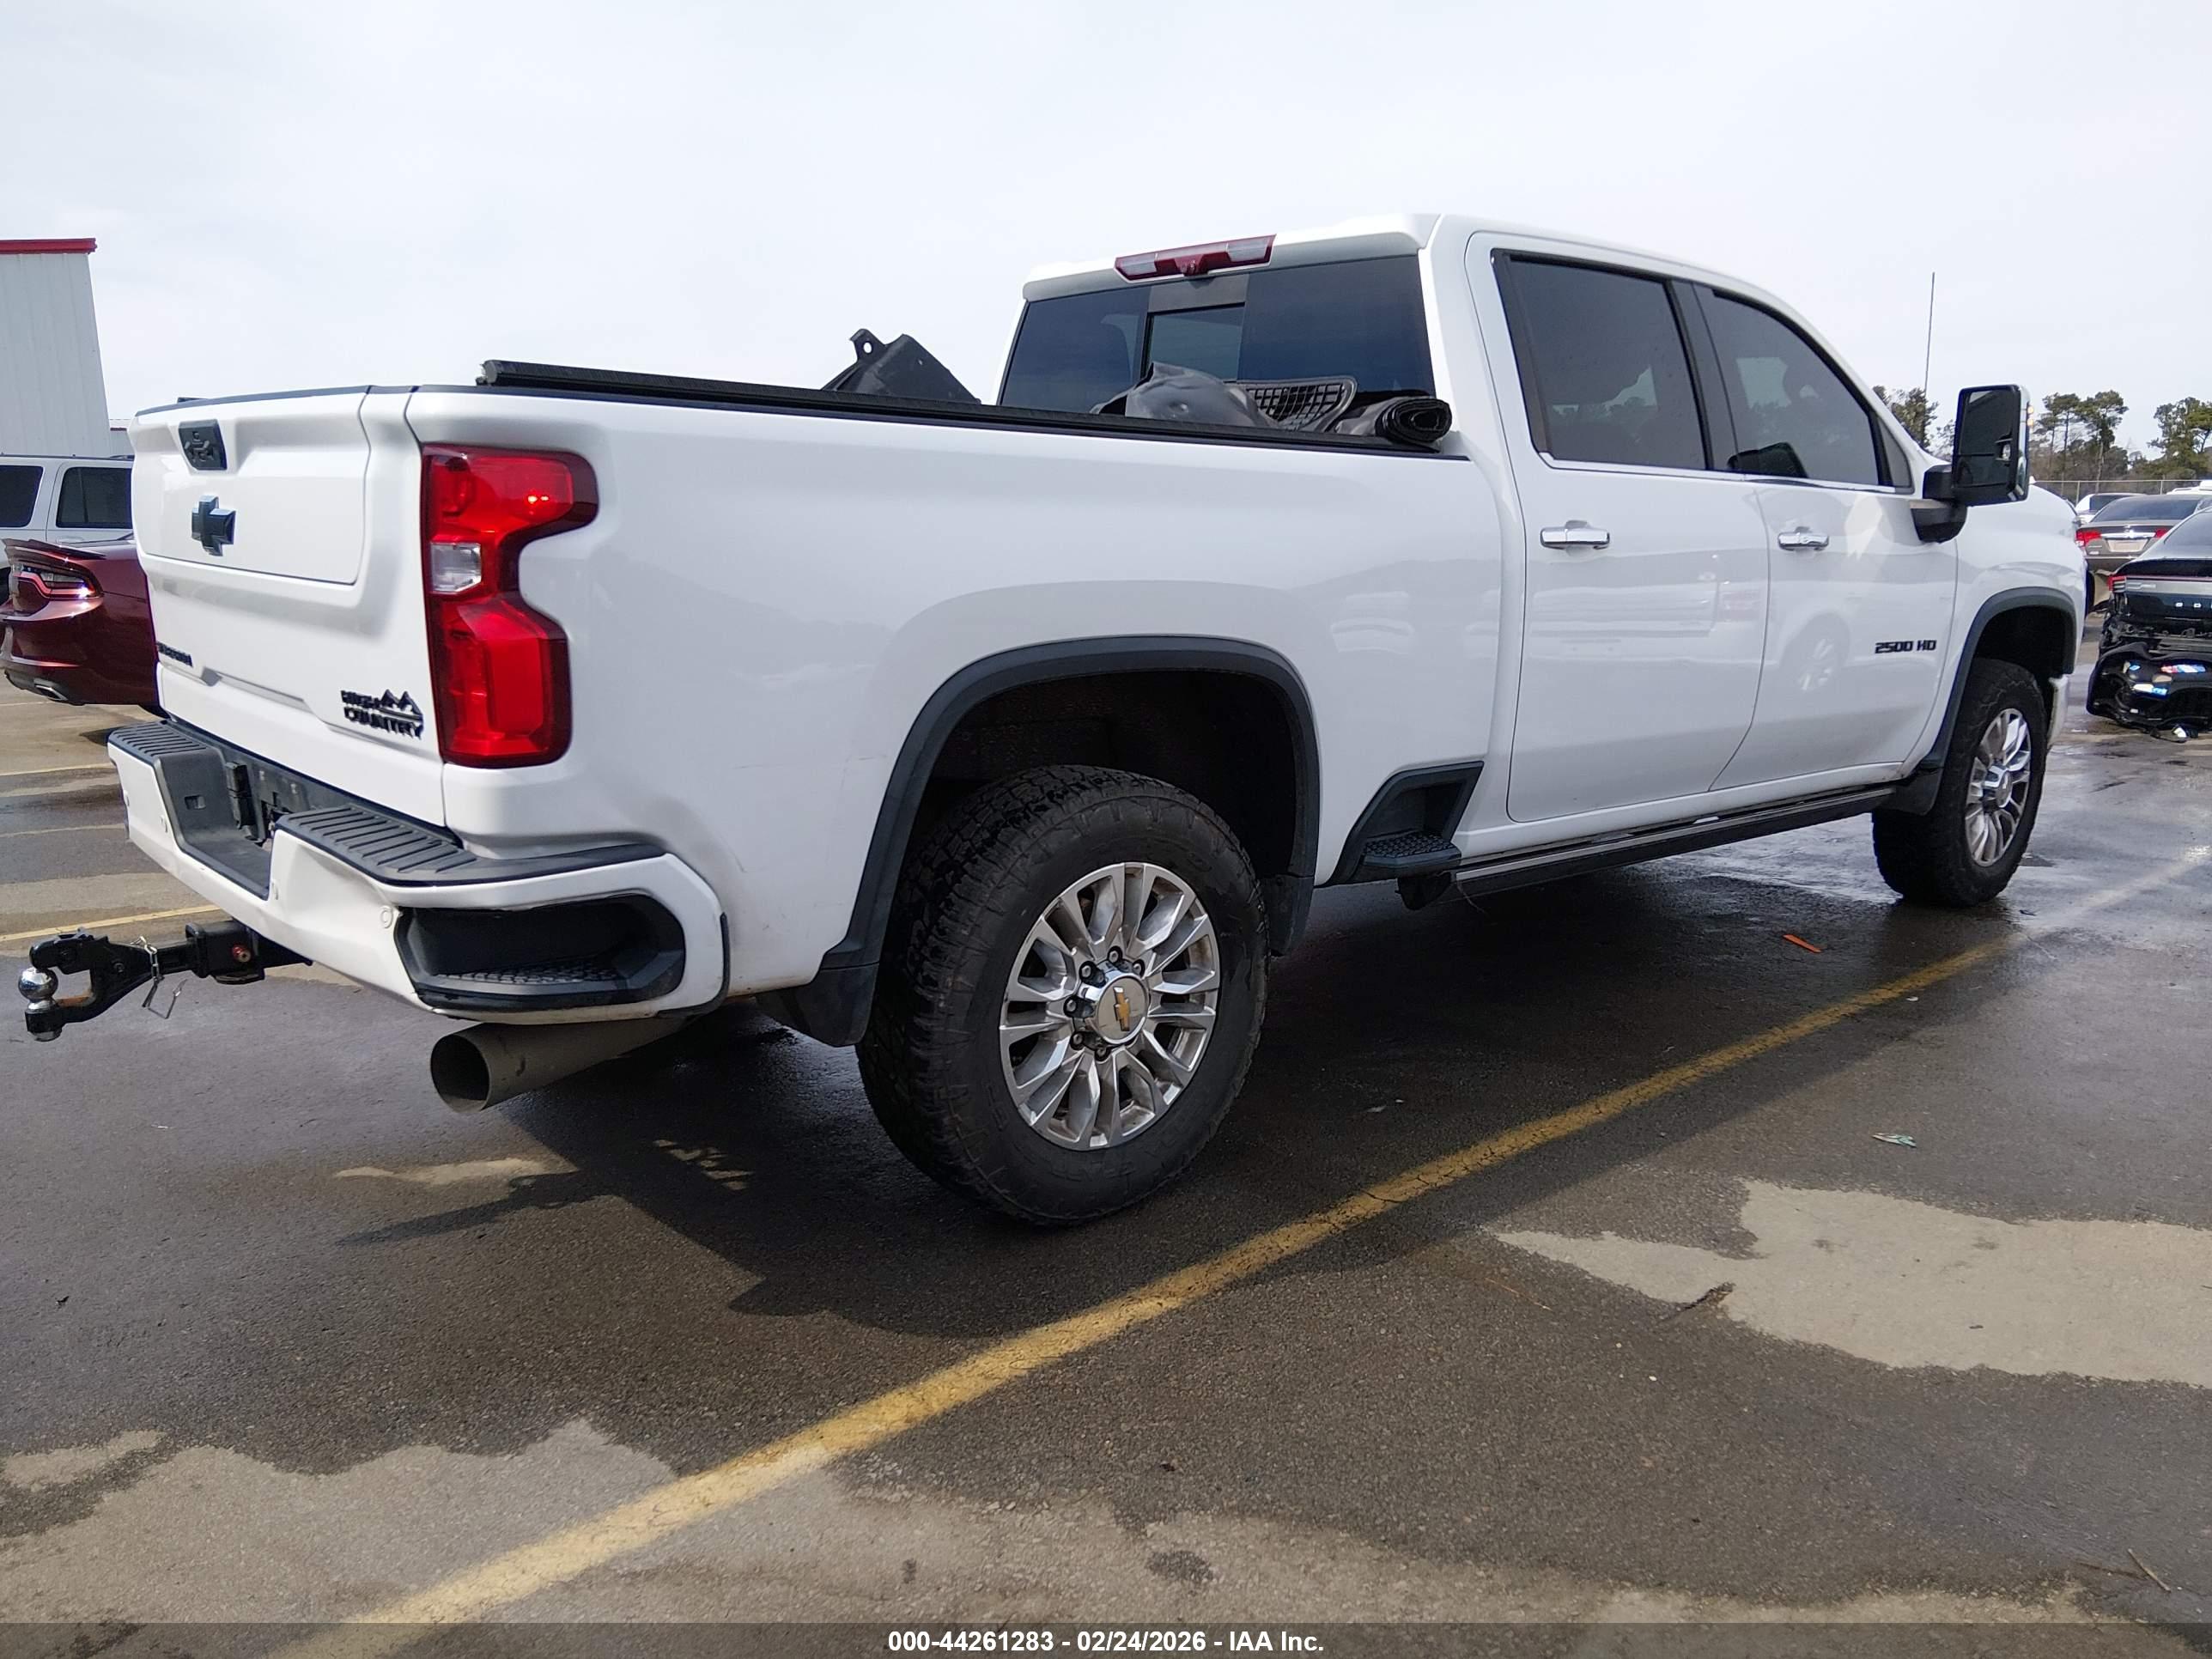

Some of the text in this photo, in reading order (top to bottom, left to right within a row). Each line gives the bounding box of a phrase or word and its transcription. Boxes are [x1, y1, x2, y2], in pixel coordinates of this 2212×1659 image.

[1875, 640, 1937, 653] 2500 HD
[344, 707, 423, 739] COUNTRY
